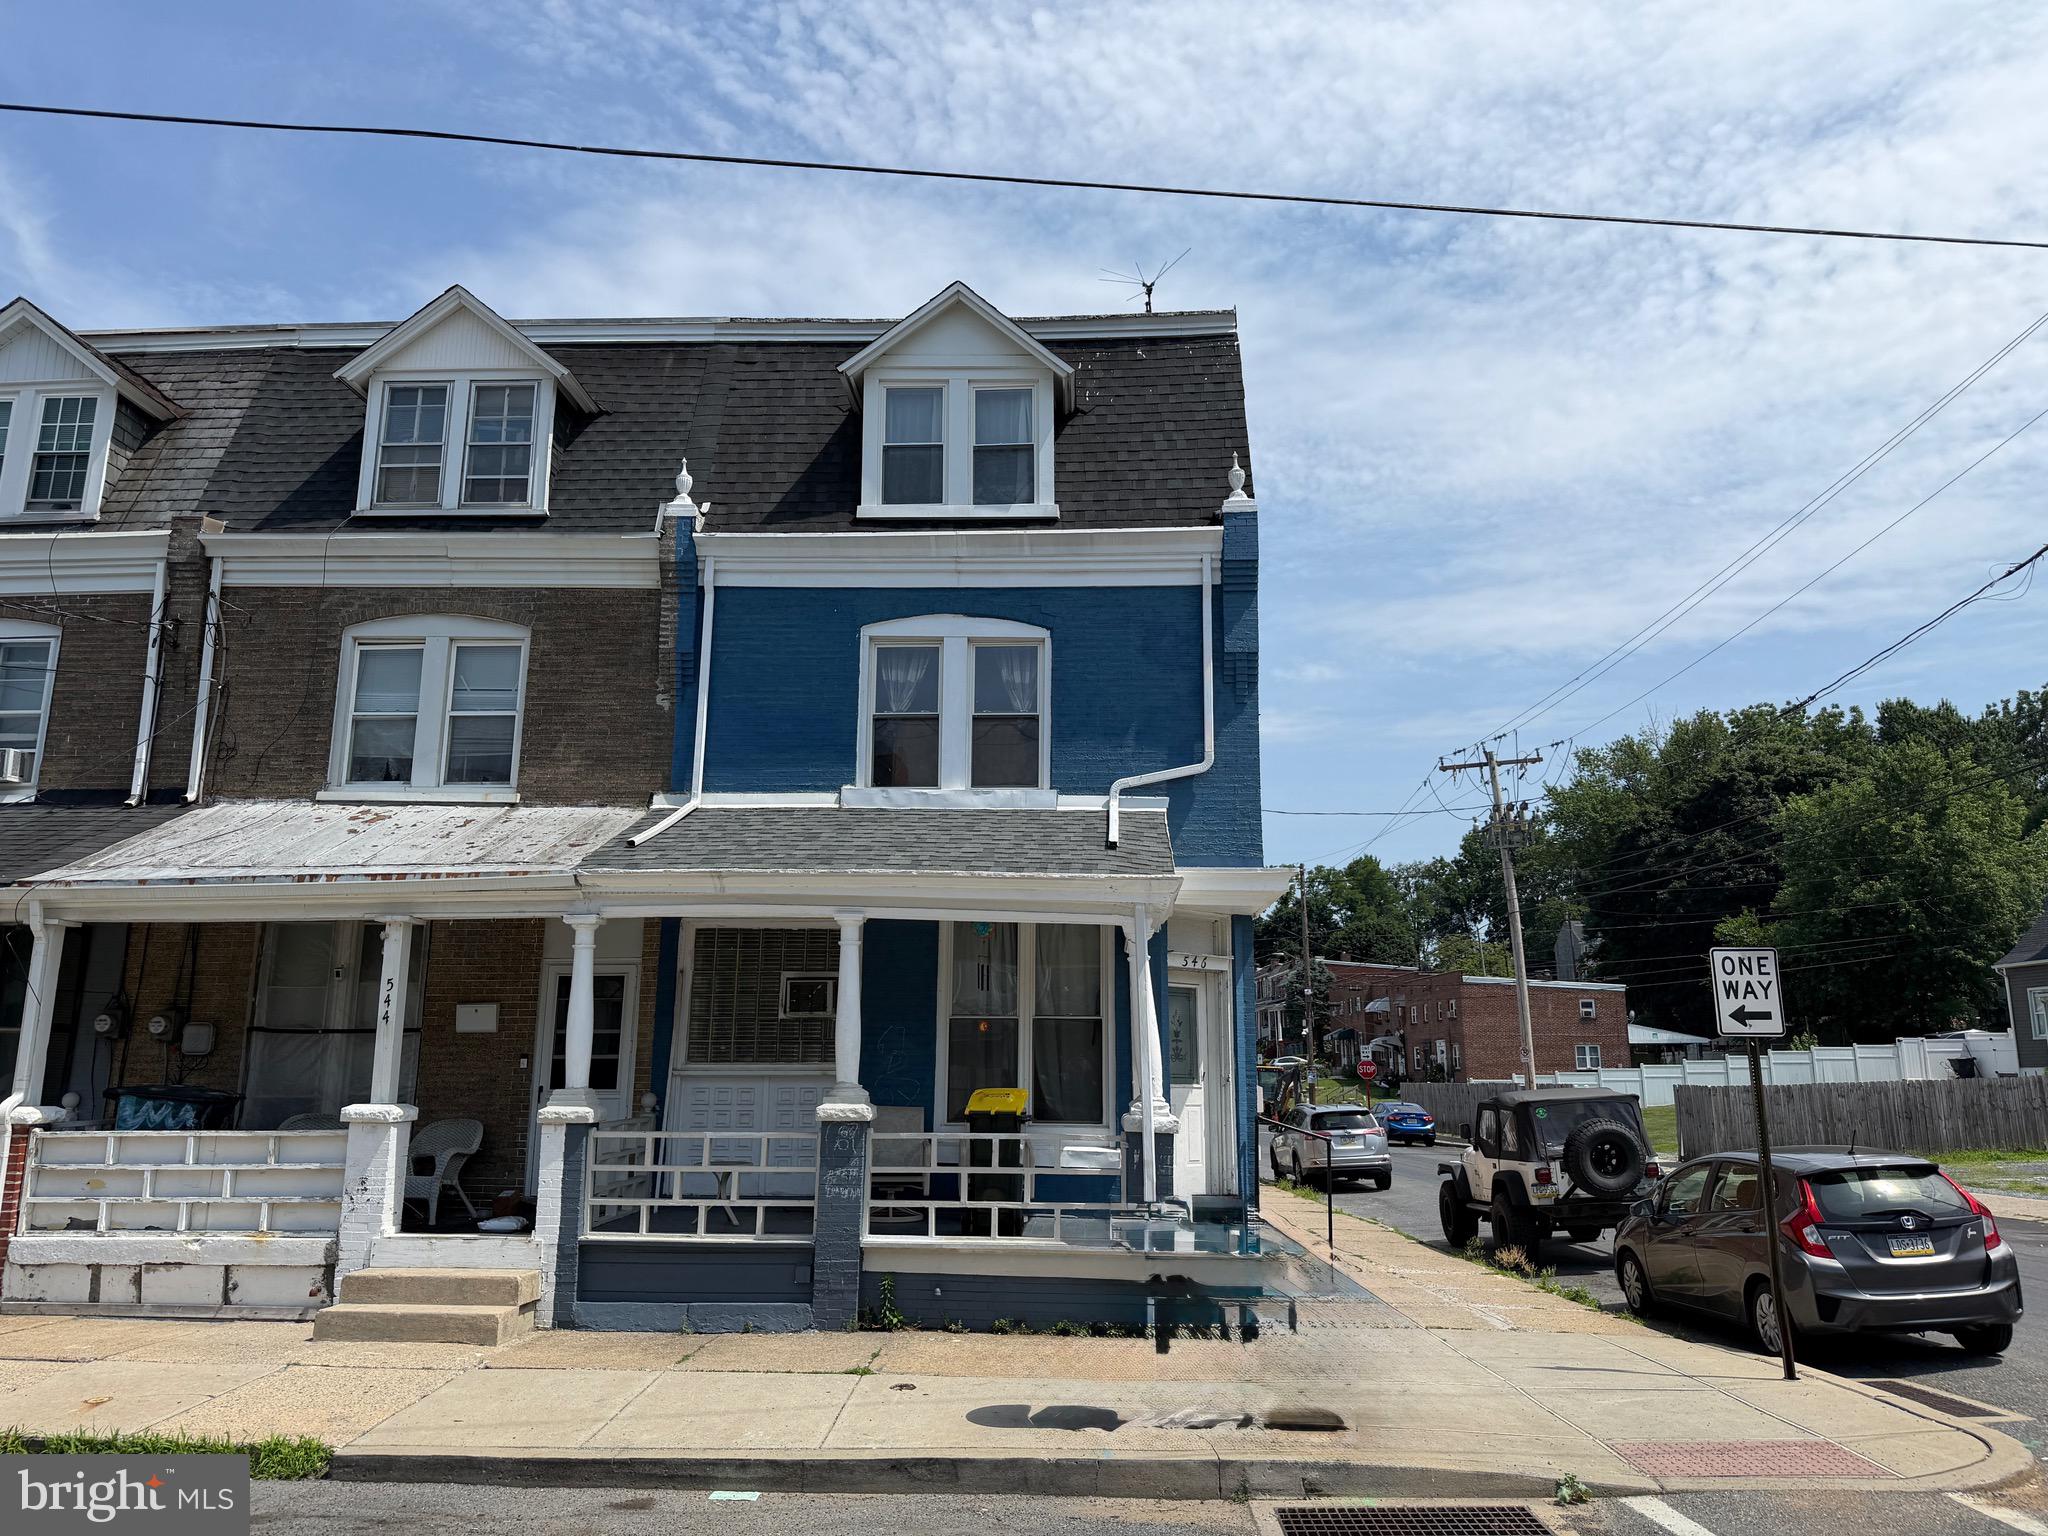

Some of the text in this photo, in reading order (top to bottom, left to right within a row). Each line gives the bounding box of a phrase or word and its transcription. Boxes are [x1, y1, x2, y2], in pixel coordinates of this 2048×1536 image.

[1182, 955, 1208, 969] 546
[1721, 955, 1771, 976] ONE
[1722, 980, 1773, 1000] WAY
[382, 977, 394, 1025] 544
